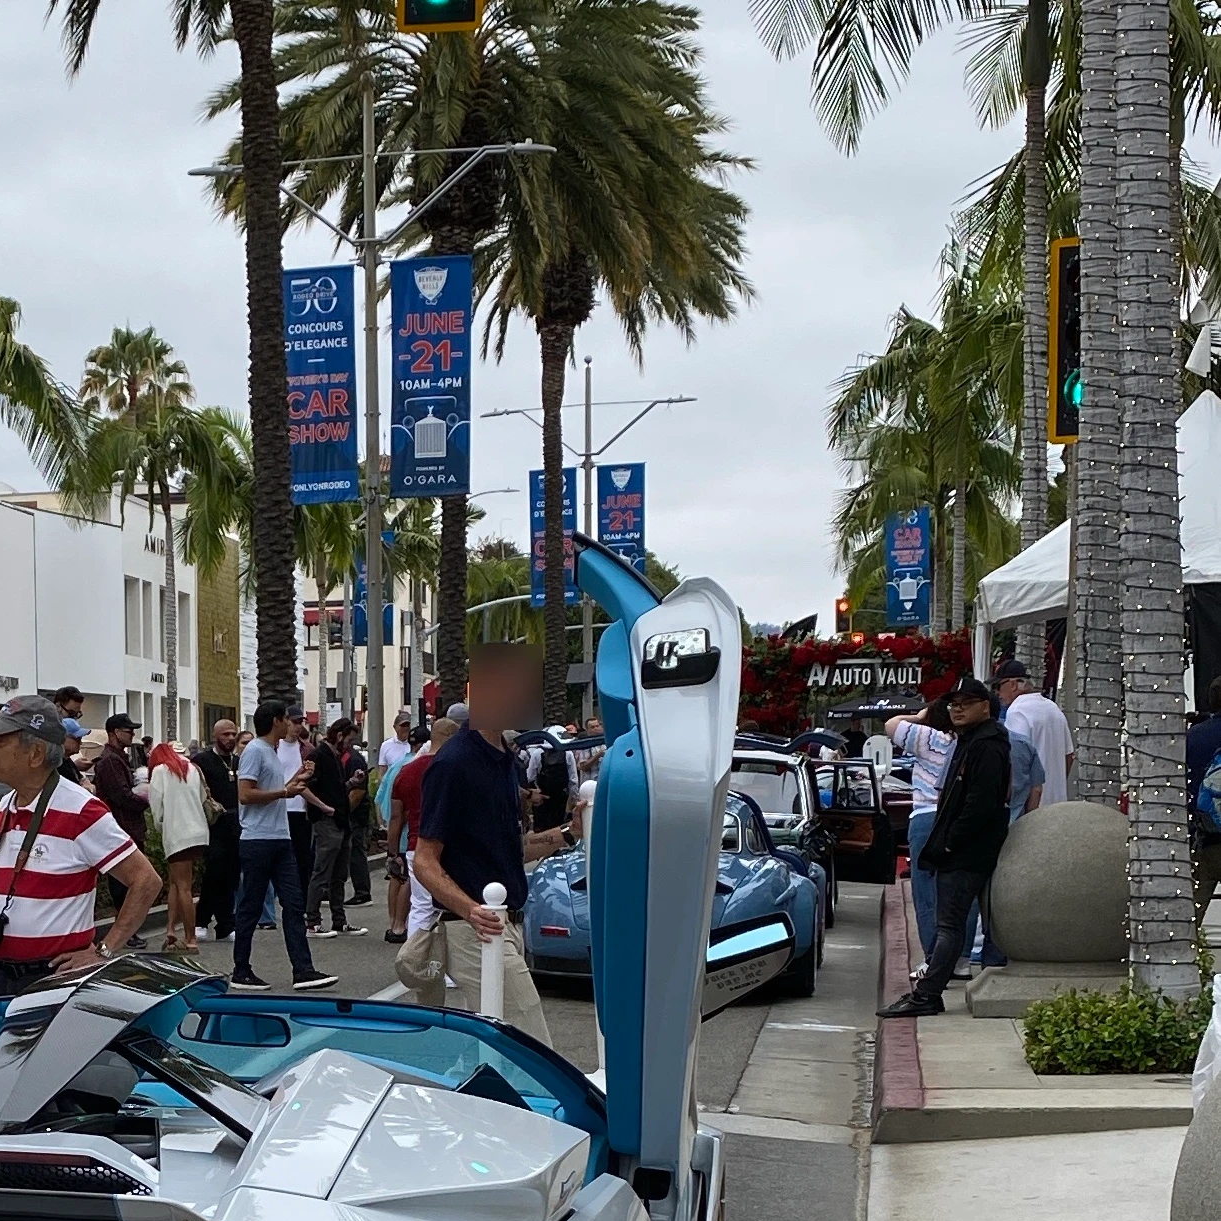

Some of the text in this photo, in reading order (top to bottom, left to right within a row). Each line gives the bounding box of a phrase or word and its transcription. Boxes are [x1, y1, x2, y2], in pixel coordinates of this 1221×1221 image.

[289, 276, 338, 316] 50
[287, 321, 344, 335] CONCOURS
[399, 311, 465, 336] JUNE
[284, 337, 348, 351] D'ELEGANCE
[399, 376, 462, 390] 10AM-4PM
[286, 388, 350, 419] CAR
[287, 422, 350, 445] SHOW
[290, 480, 351, 492] ONLYONRODEO
[403, 474, 457, 486] O'GARA
[601, 494, 642, 509] JUNE
[144, 533, 166, 557] AMIR
[535, 539, 573, 557] CR
[832, 667, 872, 686] AUTO
[878, 667, 922, 685] VAULT
